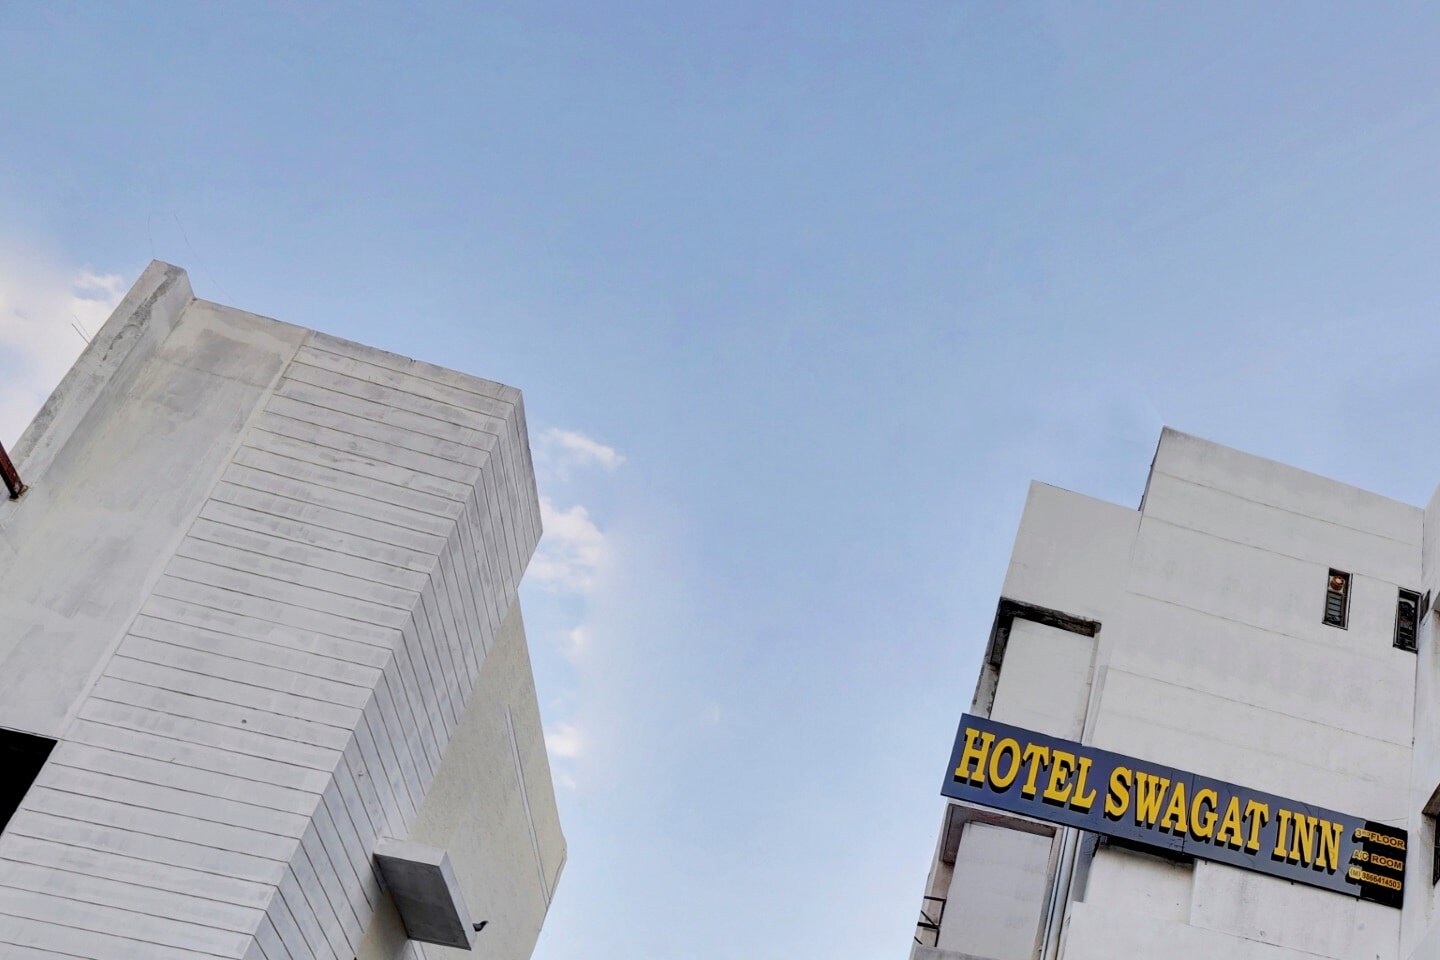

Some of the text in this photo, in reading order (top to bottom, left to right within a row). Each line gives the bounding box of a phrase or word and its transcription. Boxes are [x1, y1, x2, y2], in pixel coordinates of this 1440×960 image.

[954, 727, 1344, 872] HOTEL SWAGAT INN
[1370, 832, 1405, 849] FLOOR
[1353, 850, 1403, 870] A/C ROOM
